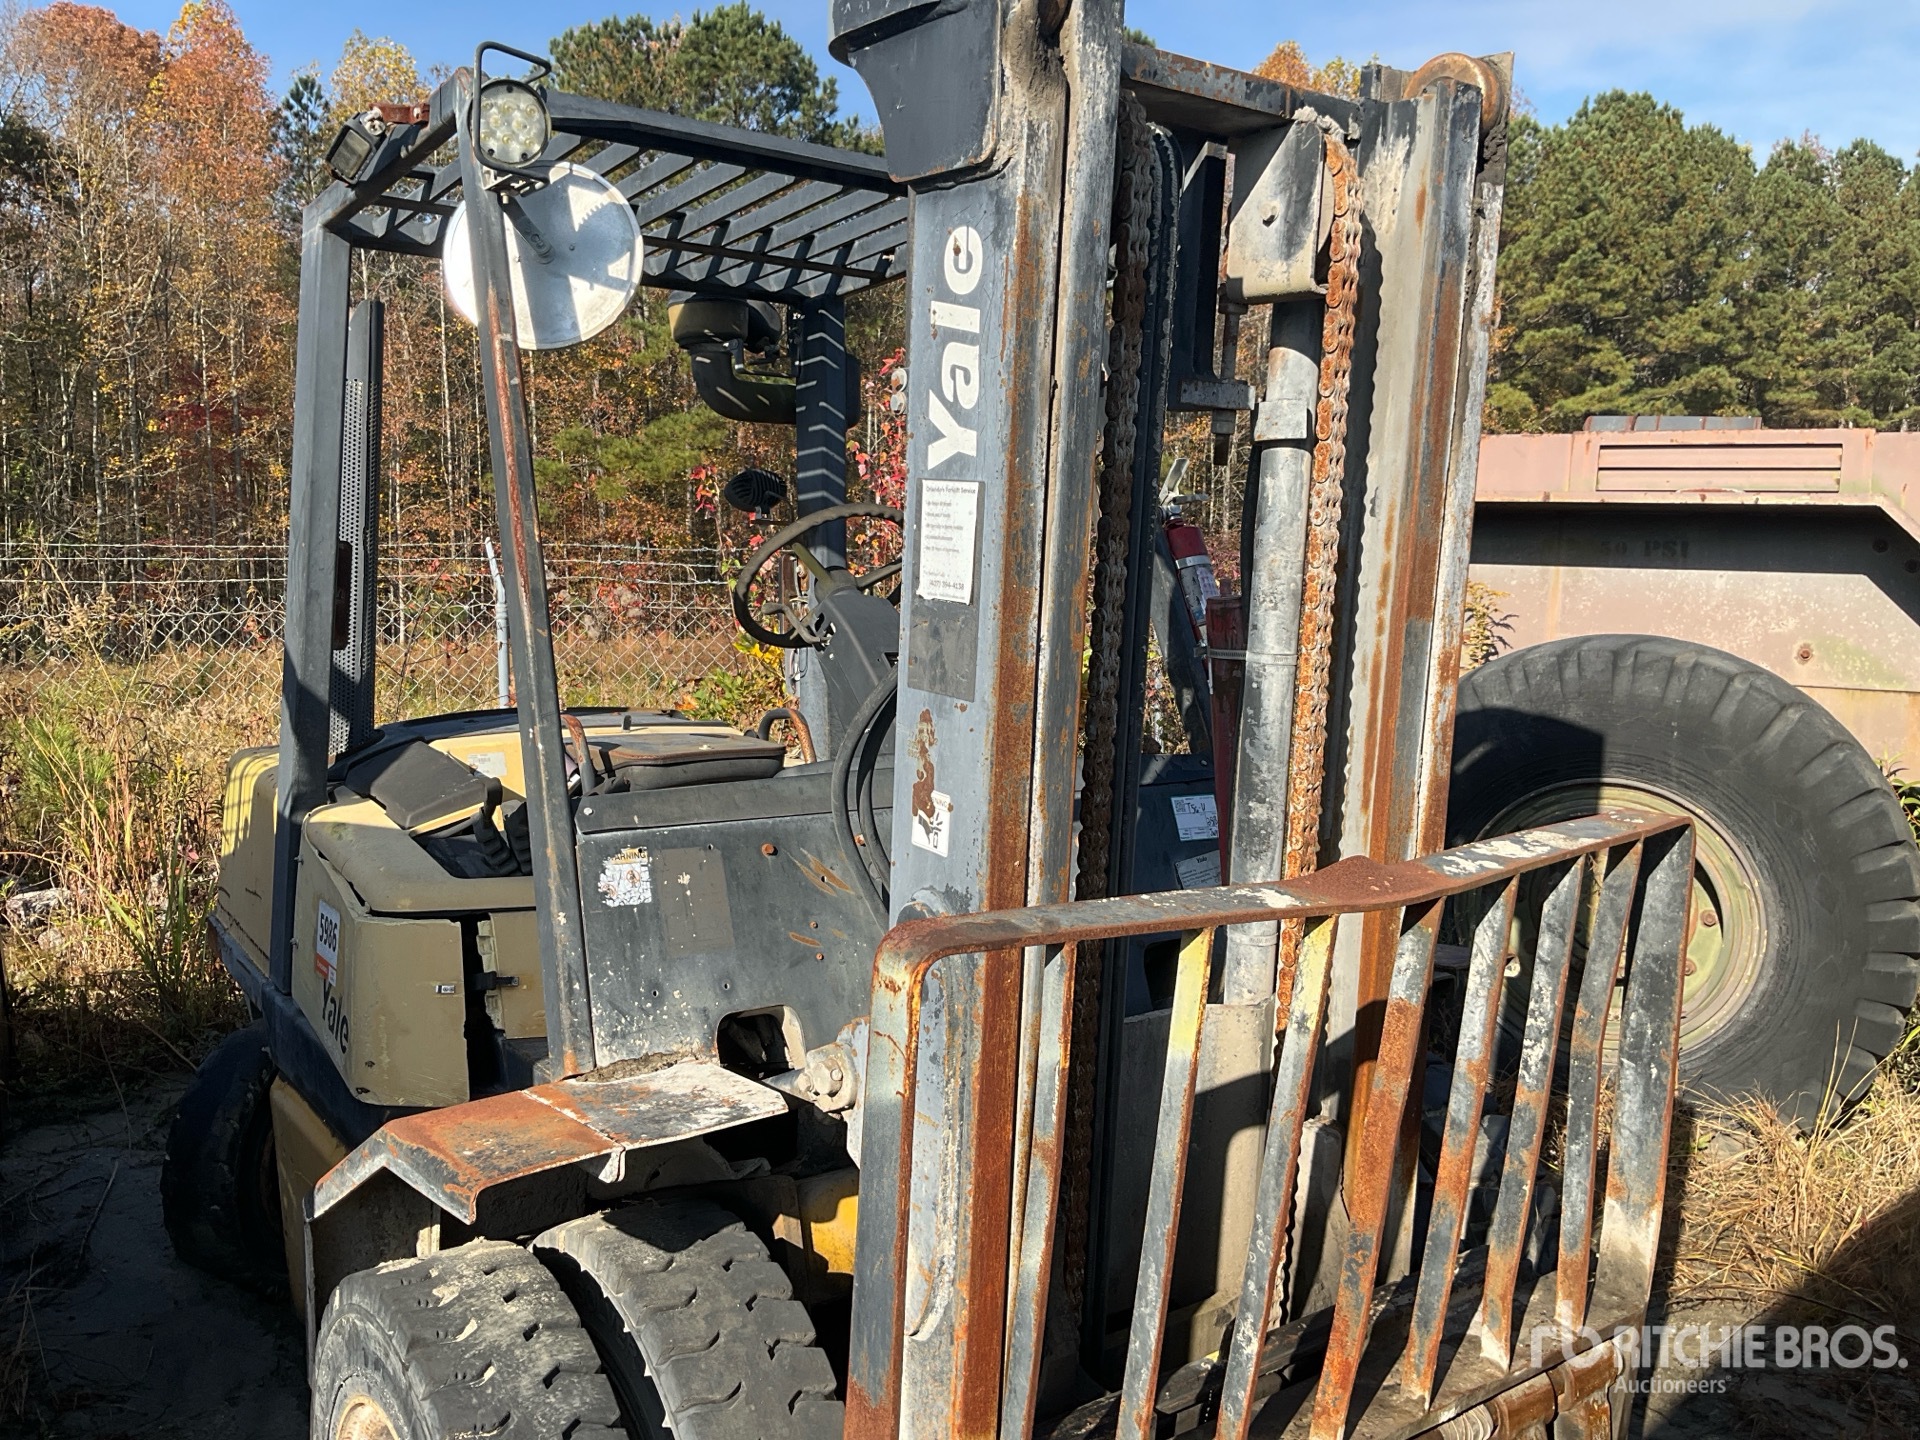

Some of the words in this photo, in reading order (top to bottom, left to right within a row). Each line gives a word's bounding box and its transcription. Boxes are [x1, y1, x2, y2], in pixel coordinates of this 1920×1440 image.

[927, 225, 983, 471] Yale
[961, 487, 976, 495] Service
[1644, 540, 1689, 559] PSI
[611, 851, 646, 861] ARNING
[319, 912, 338, 953] 5986
[322, 977, 349, 1055] Yale
